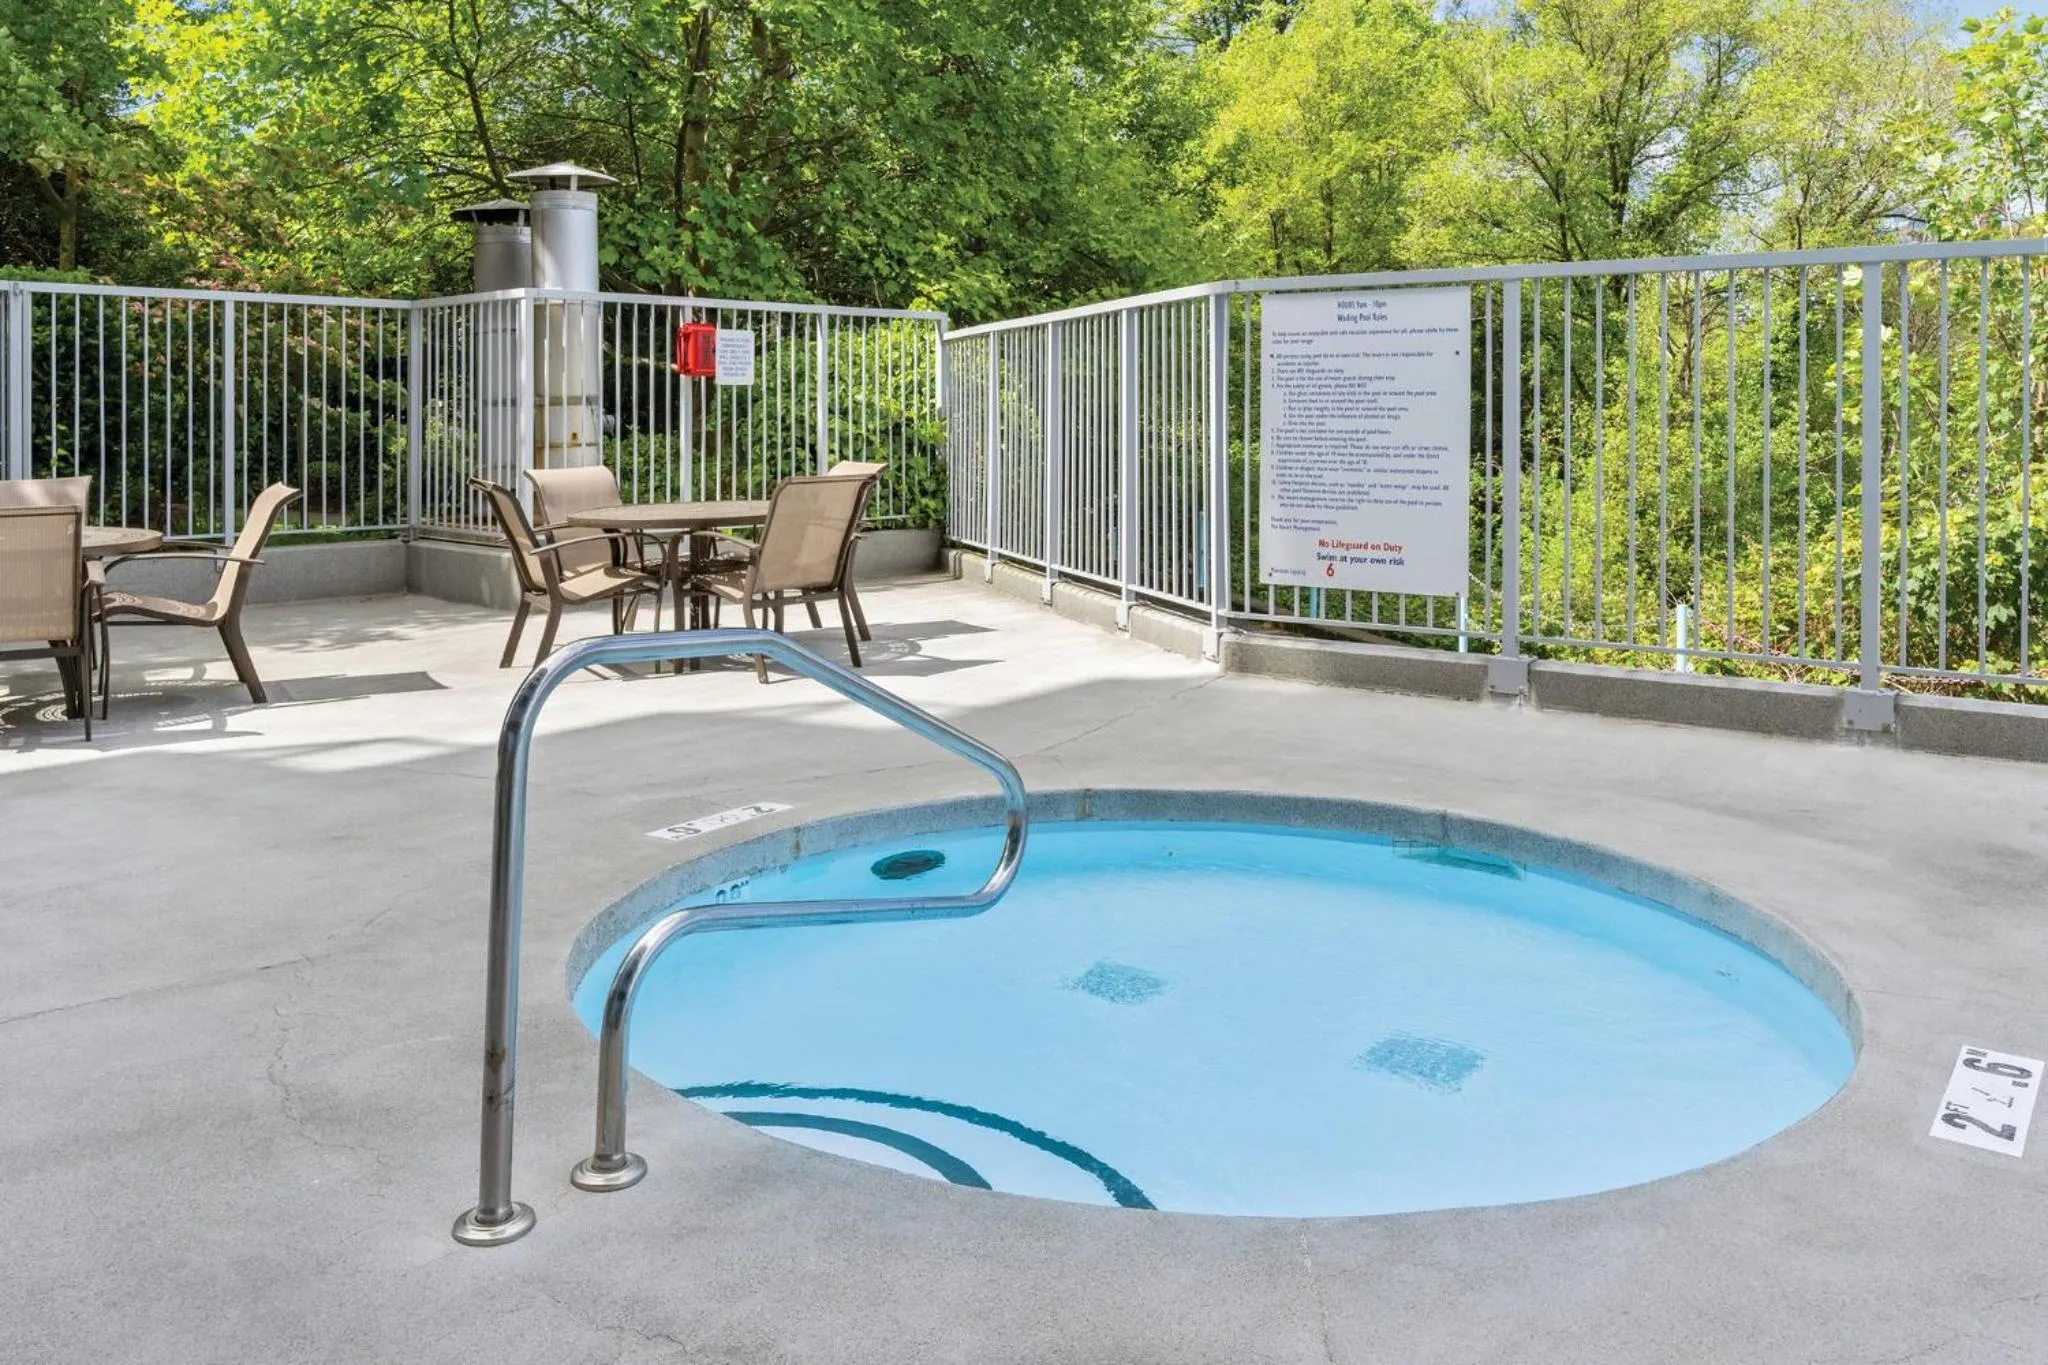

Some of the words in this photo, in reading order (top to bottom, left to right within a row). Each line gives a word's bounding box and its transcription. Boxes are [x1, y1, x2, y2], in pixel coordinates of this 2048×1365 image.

[1337, 313, 1358, 323] Wading
[1359, 313, 1371, 321] Pool
[1372, 313, 1388, 321] Rules
[1318, 539, 1329, 548] No
[1332, 540, 1369, 551] Lifeguard
[1370, 543, 1381, 551] on
[1383, 542, 1402, 554] Duty
[1316, 552, 1337, 562] Swim
[1339, 554, 1347, 563] at
[1349, 556, 1368, 565] your
[1370, 557, 1387, 565] own
[1389, 557, 1405, 566] risk
[1326, 563, 1335, 577] 6
